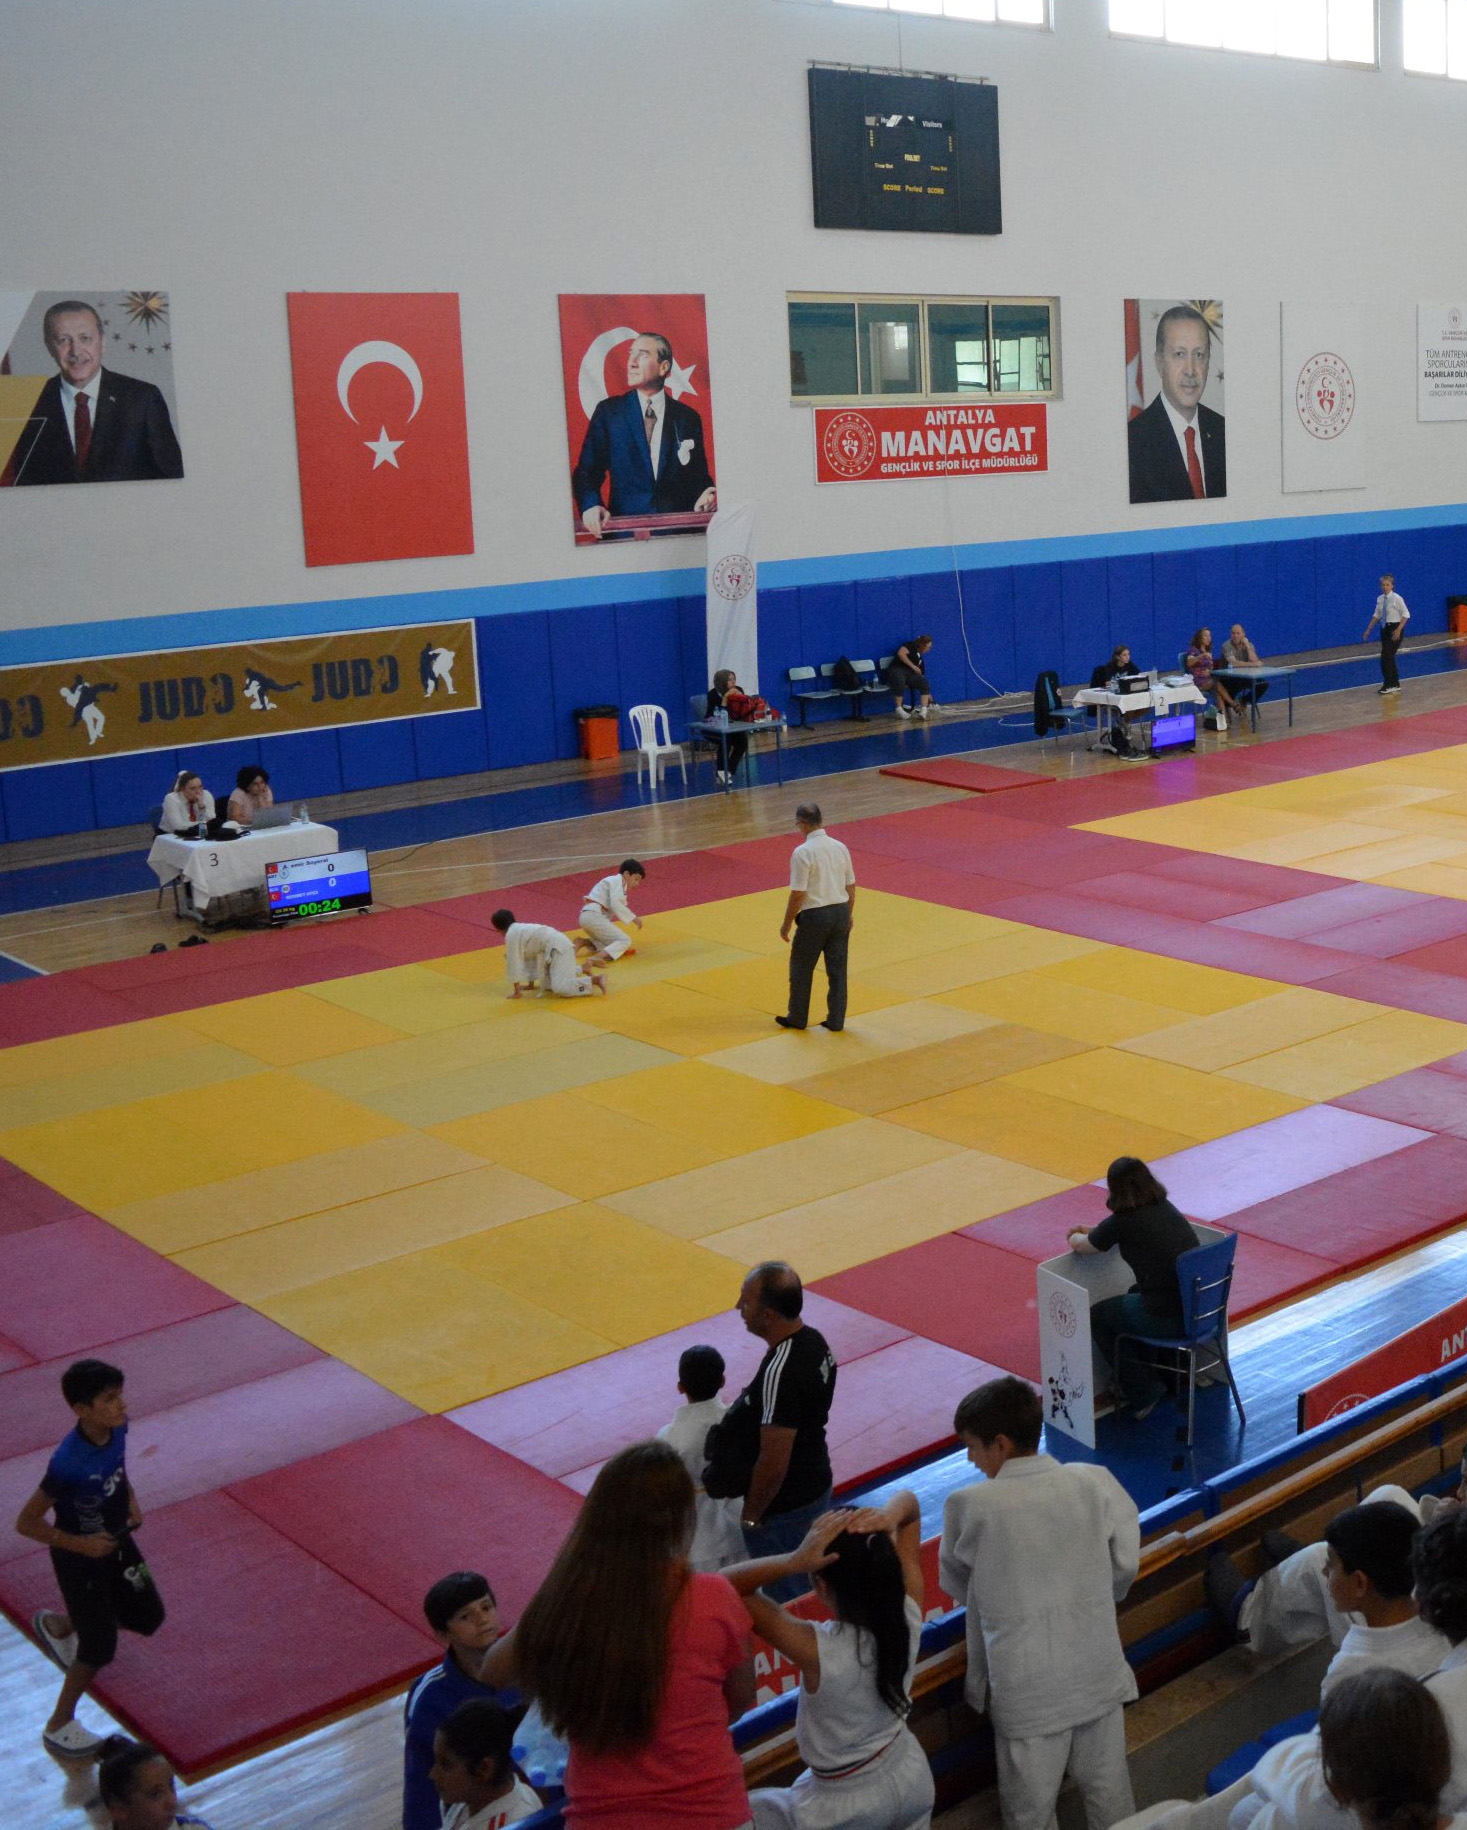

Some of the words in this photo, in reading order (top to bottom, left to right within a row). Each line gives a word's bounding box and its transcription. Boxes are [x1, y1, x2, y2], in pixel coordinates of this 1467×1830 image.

[1426, 348, 1440, 358] TÜM
[1424, 371, 1454, 379] BAŞARILAR
[925, 409, 995, 425] ANTALYA
[881, 426, 1036, 458] MANAVGAT
[881, 459, 920, 474] GENÇLİK
[922, 461, 934, 471] VE
[936, 460, 960, 471] SPOR
[961, 457, 980, 471] İLÇE
[982, 453, 1038, 468] MÜDÜRLÜĞÜ
[138, 672, 235, 723] JUDO
[311, 654, 399, 703] JUDO
[1159, 696, 1164, 706] 2
[209, 853, 219, 867] 3
[327, 863, 335, 872] 0
[328, 877, 337, 887] 0
[299, 898, 341, 916] 00:24
